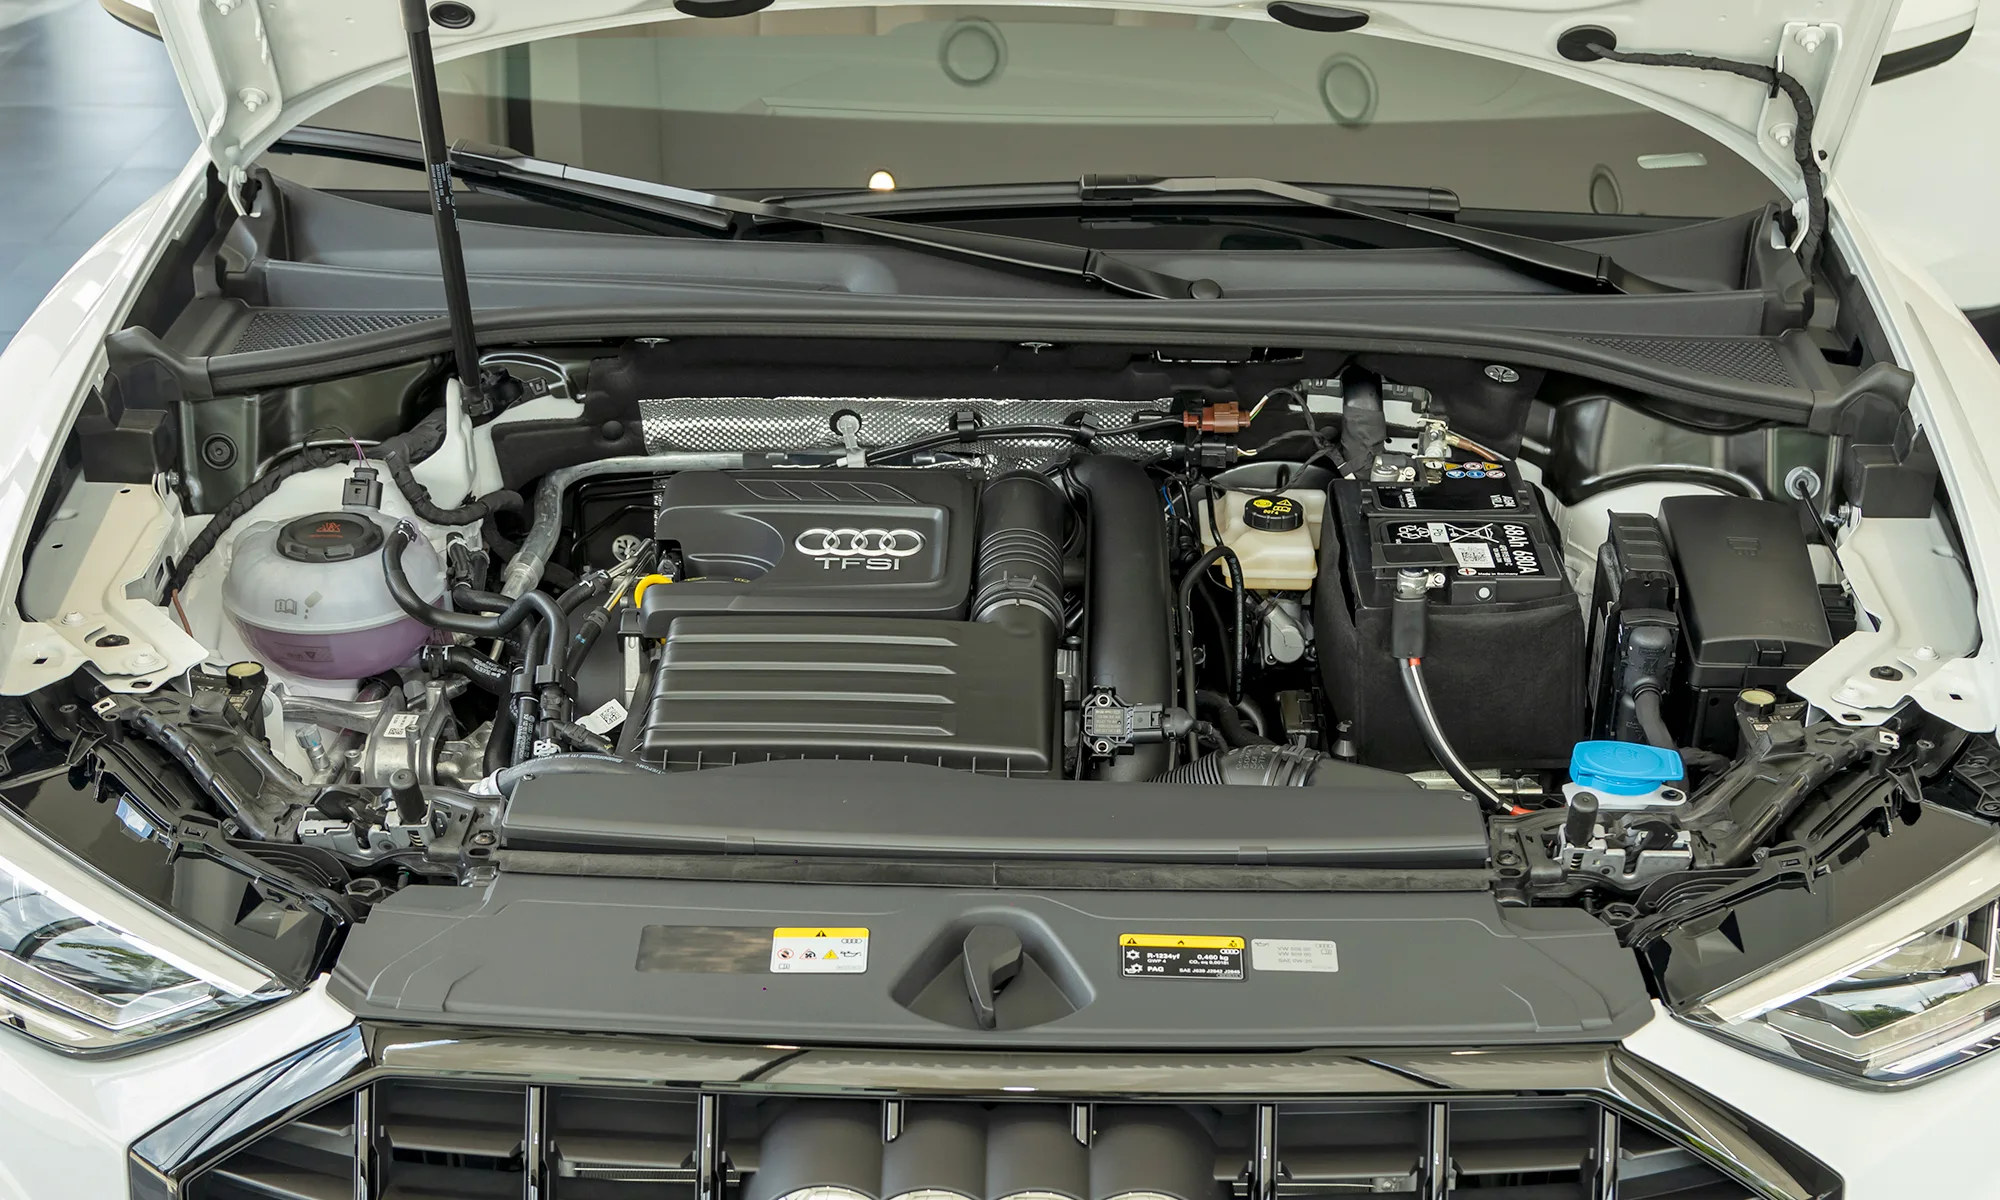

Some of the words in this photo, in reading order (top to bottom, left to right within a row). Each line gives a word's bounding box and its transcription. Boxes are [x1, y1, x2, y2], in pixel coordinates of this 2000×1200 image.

[1503, 524, 1529, 548] 68Ah
[814, 557, 900, 571] TFSI
[1511, 551, 1540, 574] 680A
[1146, 952, 1180, 960] R-1234yf
[1219, 954, 1229, 962] kg
